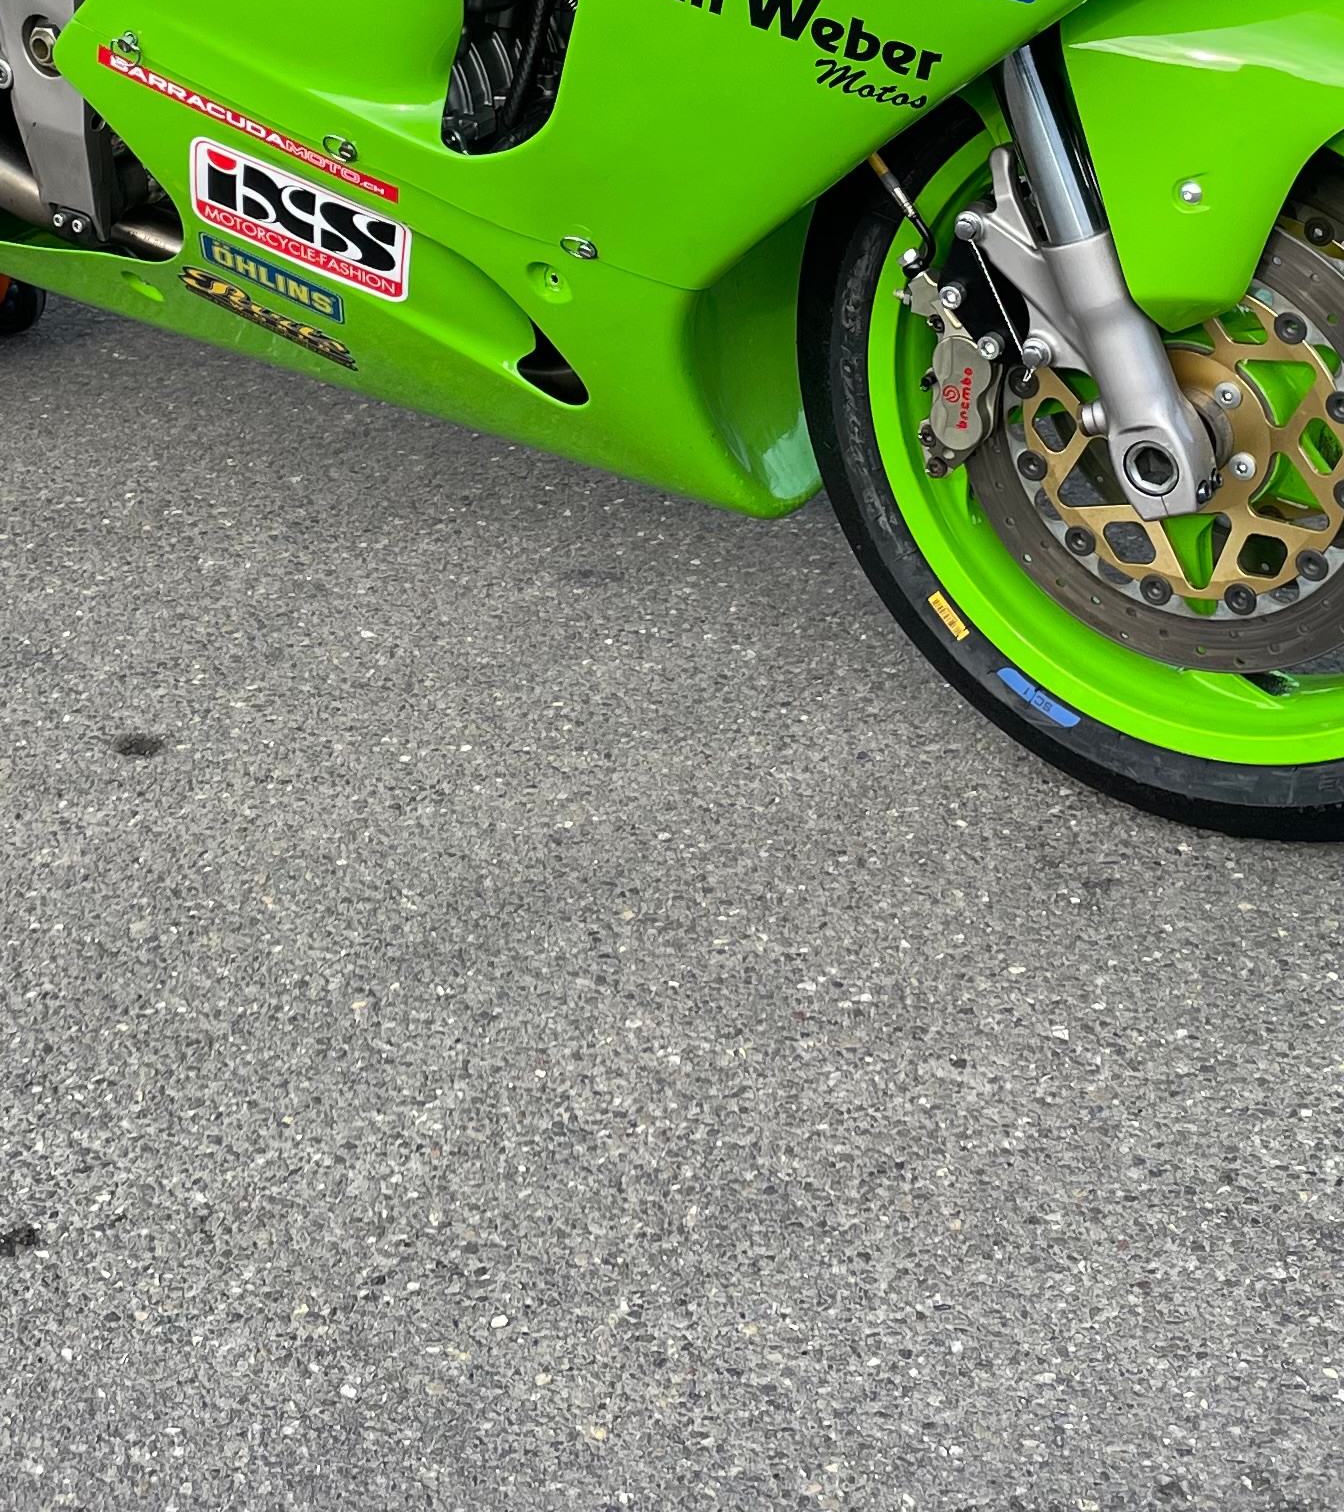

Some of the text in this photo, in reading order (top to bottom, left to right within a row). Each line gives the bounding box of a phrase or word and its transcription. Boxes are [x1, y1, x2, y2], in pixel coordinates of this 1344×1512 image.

[814, 58, 928, 110] Motos
[211, 240, 336, 316] ÖHLINS
[956, 367, 973, 430] brembo
